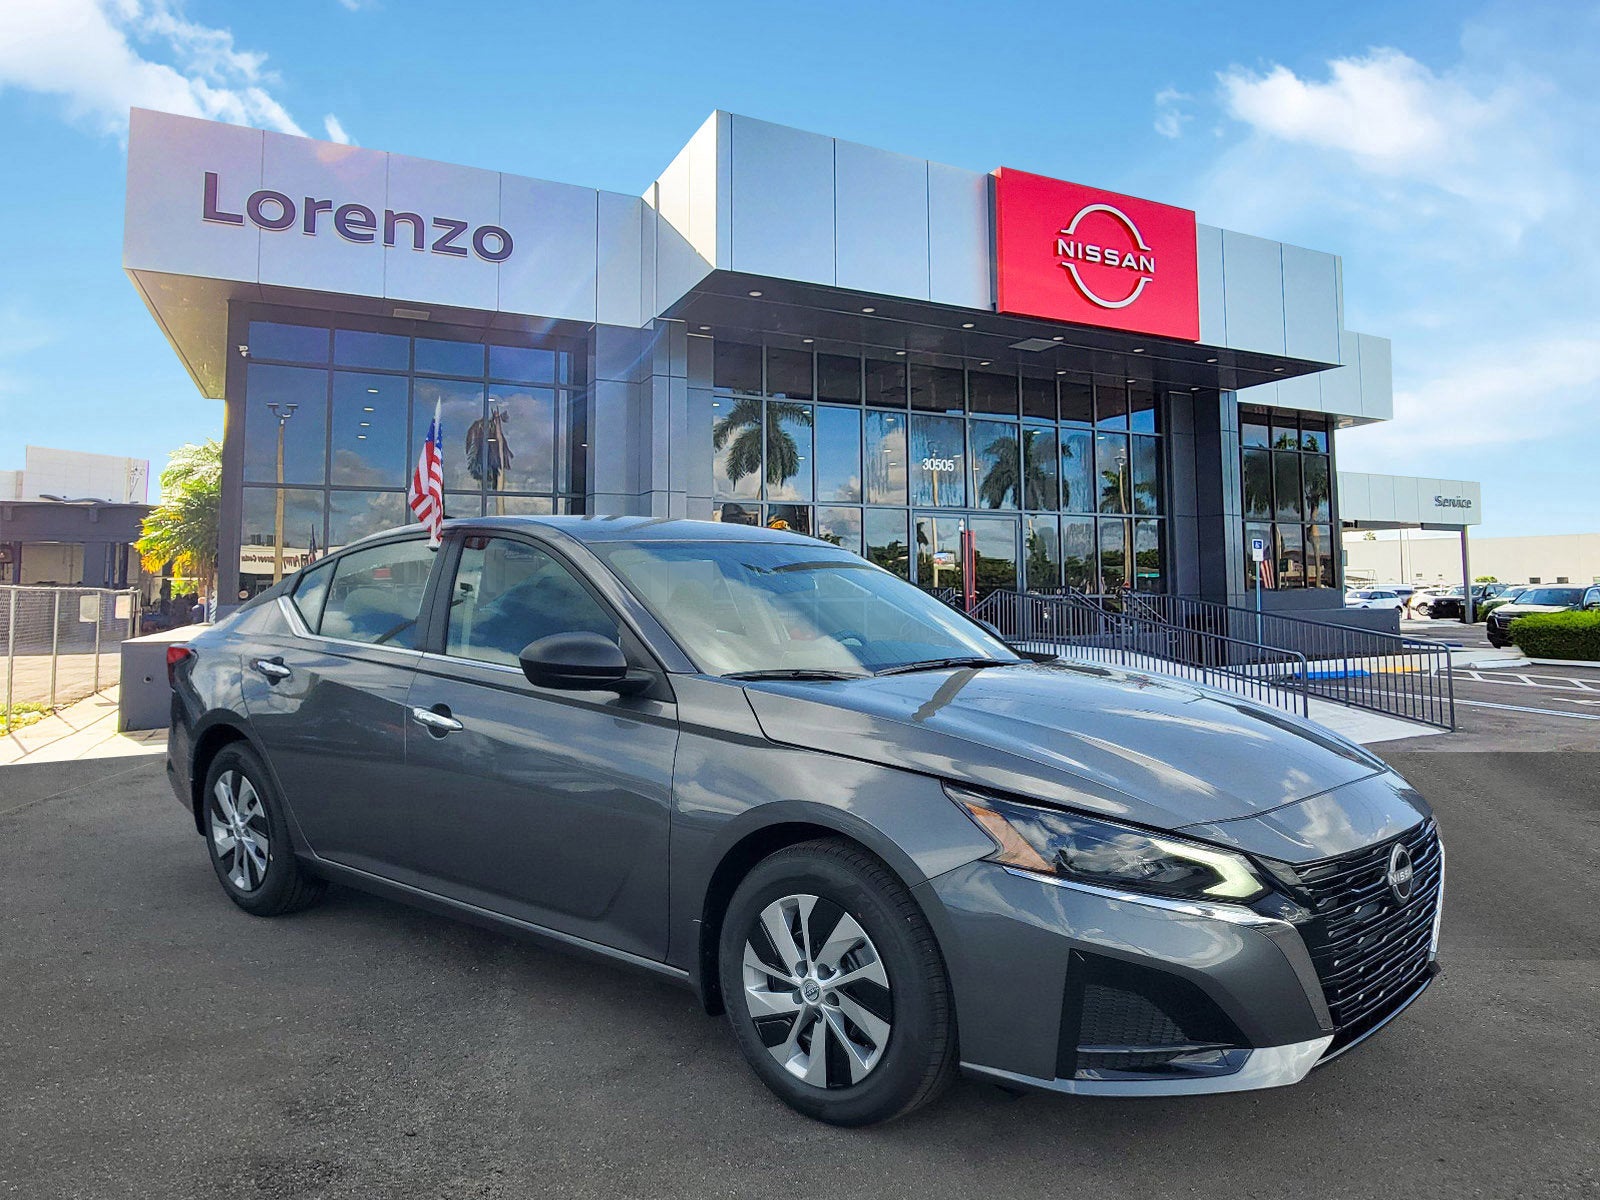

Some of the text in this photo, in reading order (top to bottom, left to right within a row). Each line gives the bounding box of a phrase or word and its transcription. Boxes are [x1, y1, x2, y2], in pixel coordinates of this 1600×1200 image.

[202, 171, 514, 262] Lorenzo
[1055, 238, 1155, 274] NISSAN
[922, 457, 955, 472] 30505
[1434, 495, 1472, 509] Service
[1388, 868, 1412, 885] NISS
